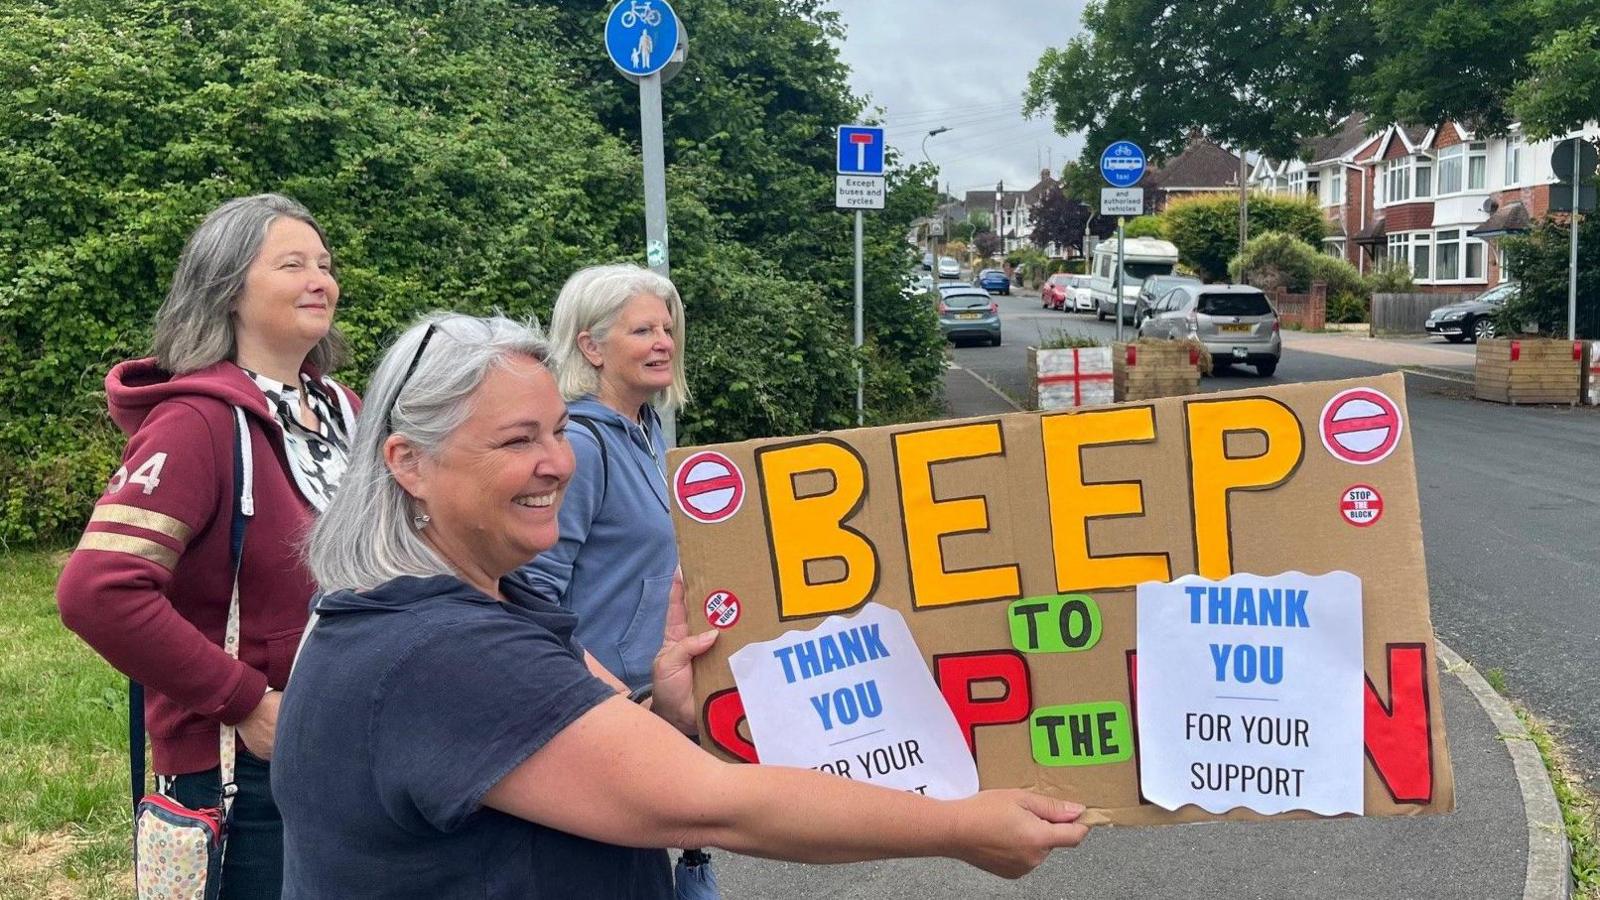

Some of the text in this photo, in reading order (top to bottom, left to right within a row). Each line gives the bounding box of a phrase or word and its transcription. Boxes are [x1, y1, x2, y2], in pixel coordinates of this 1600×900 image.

[839, 187, 863, 195] buses
[846, 179, 875, 187] Except
[755, 395, 1305, 621] BEEP
[1349, 491, 1370, 500] STOP
[707, 594, 722, 612] STOP
[719, 607, 736, 624] BLOCK
[1184, 586, 1311, 629] THANK
[1014, 599, 1093, 651] TO
[773, 623, 891, 684] THANK
[1208, 643, 1284, 685] YOU
[809, 679, 884, 731] YOU
[1035, 711, 1120, 758] THE
[1185, 712, 1310, 748] FOR YOUR
[855, 739, 924, 779] YOUR
[1190, 762, 1305, 798] SUPPORT
